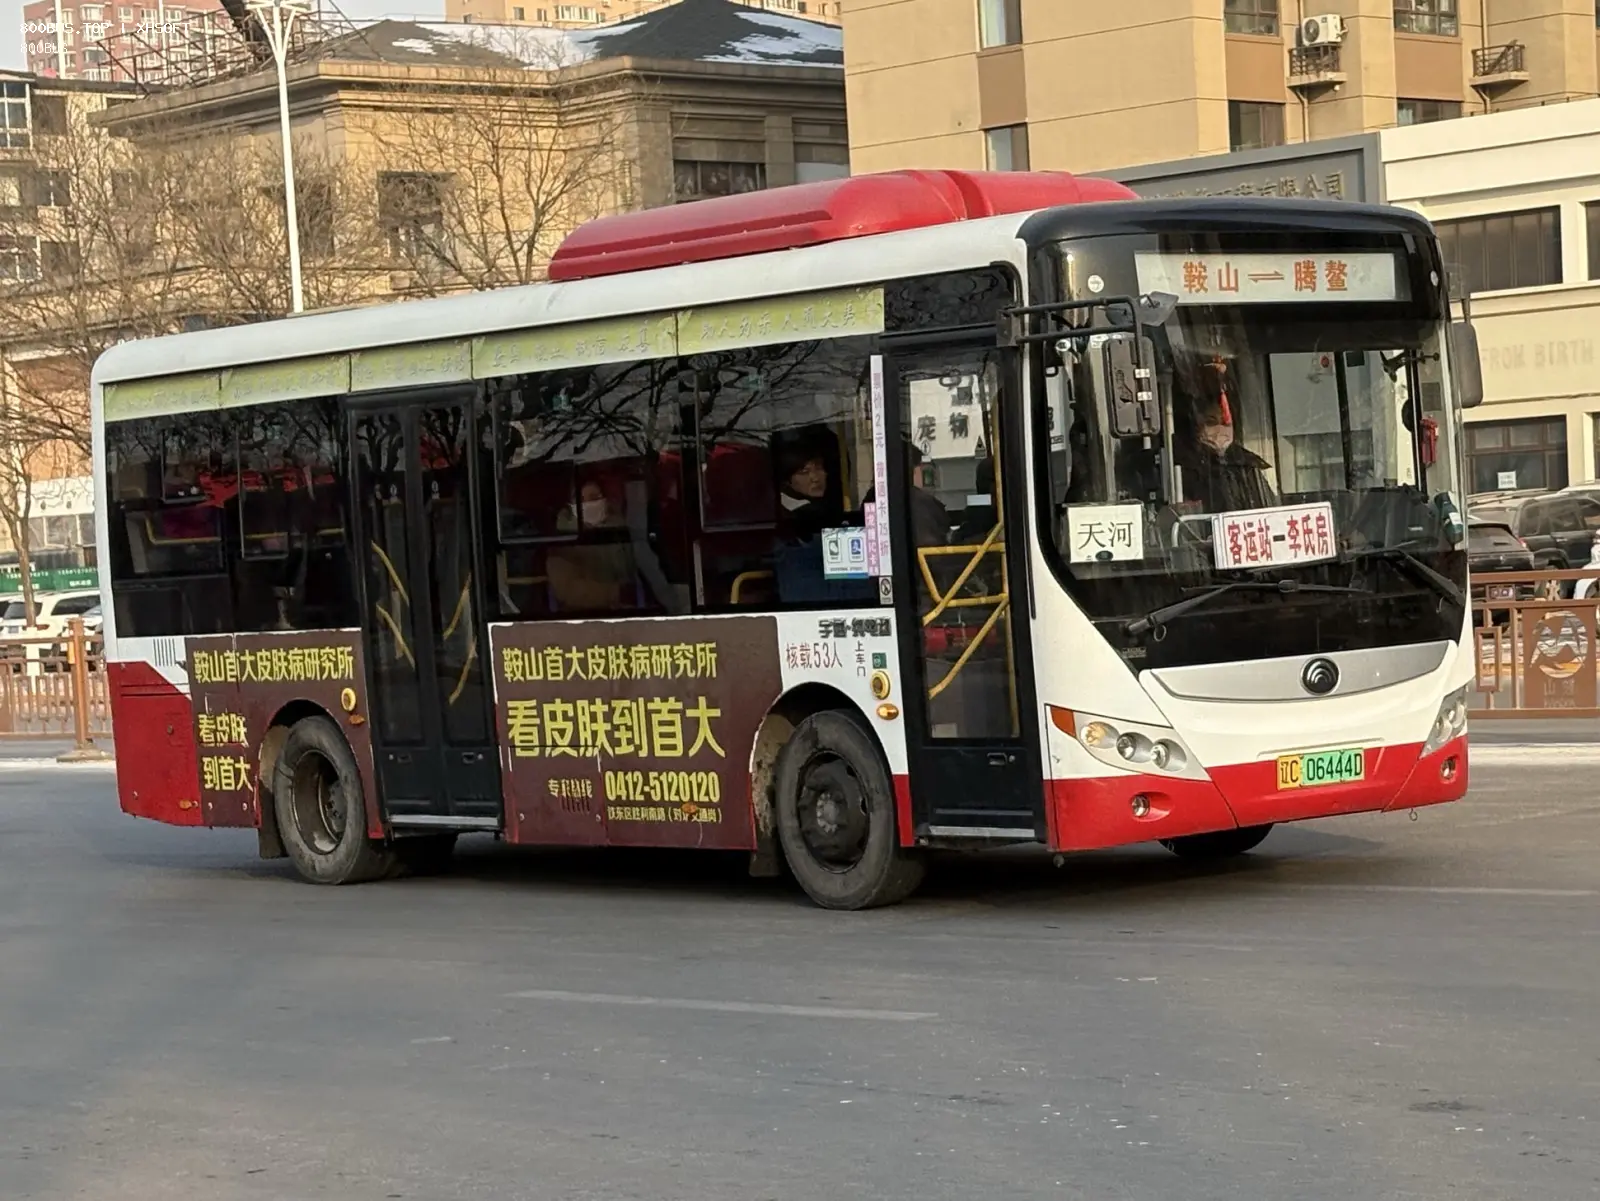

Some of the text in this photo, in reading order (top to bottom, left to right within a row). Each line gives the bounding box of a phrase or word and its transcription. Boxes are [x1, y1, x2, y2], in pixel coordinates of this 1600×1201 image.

[1182, 259, 1349, 294] 鞍山 腾鳌
[1077, 520, 1134, 549] 天河
[192, 646, 354, 684] 鞍山首大皮肤病研究所
[502, 642, 718, 683] 鞍山首大皮肤病研究所
[786, 641, 843, 670] 核载53人
[197, 712, 250, 749] 看皮肤
[506, 696, 726, 758] 看皮肤到首大
[202, 756, 254, 792] 到首大
[604, 770, 721, 803] 0412-5120120
